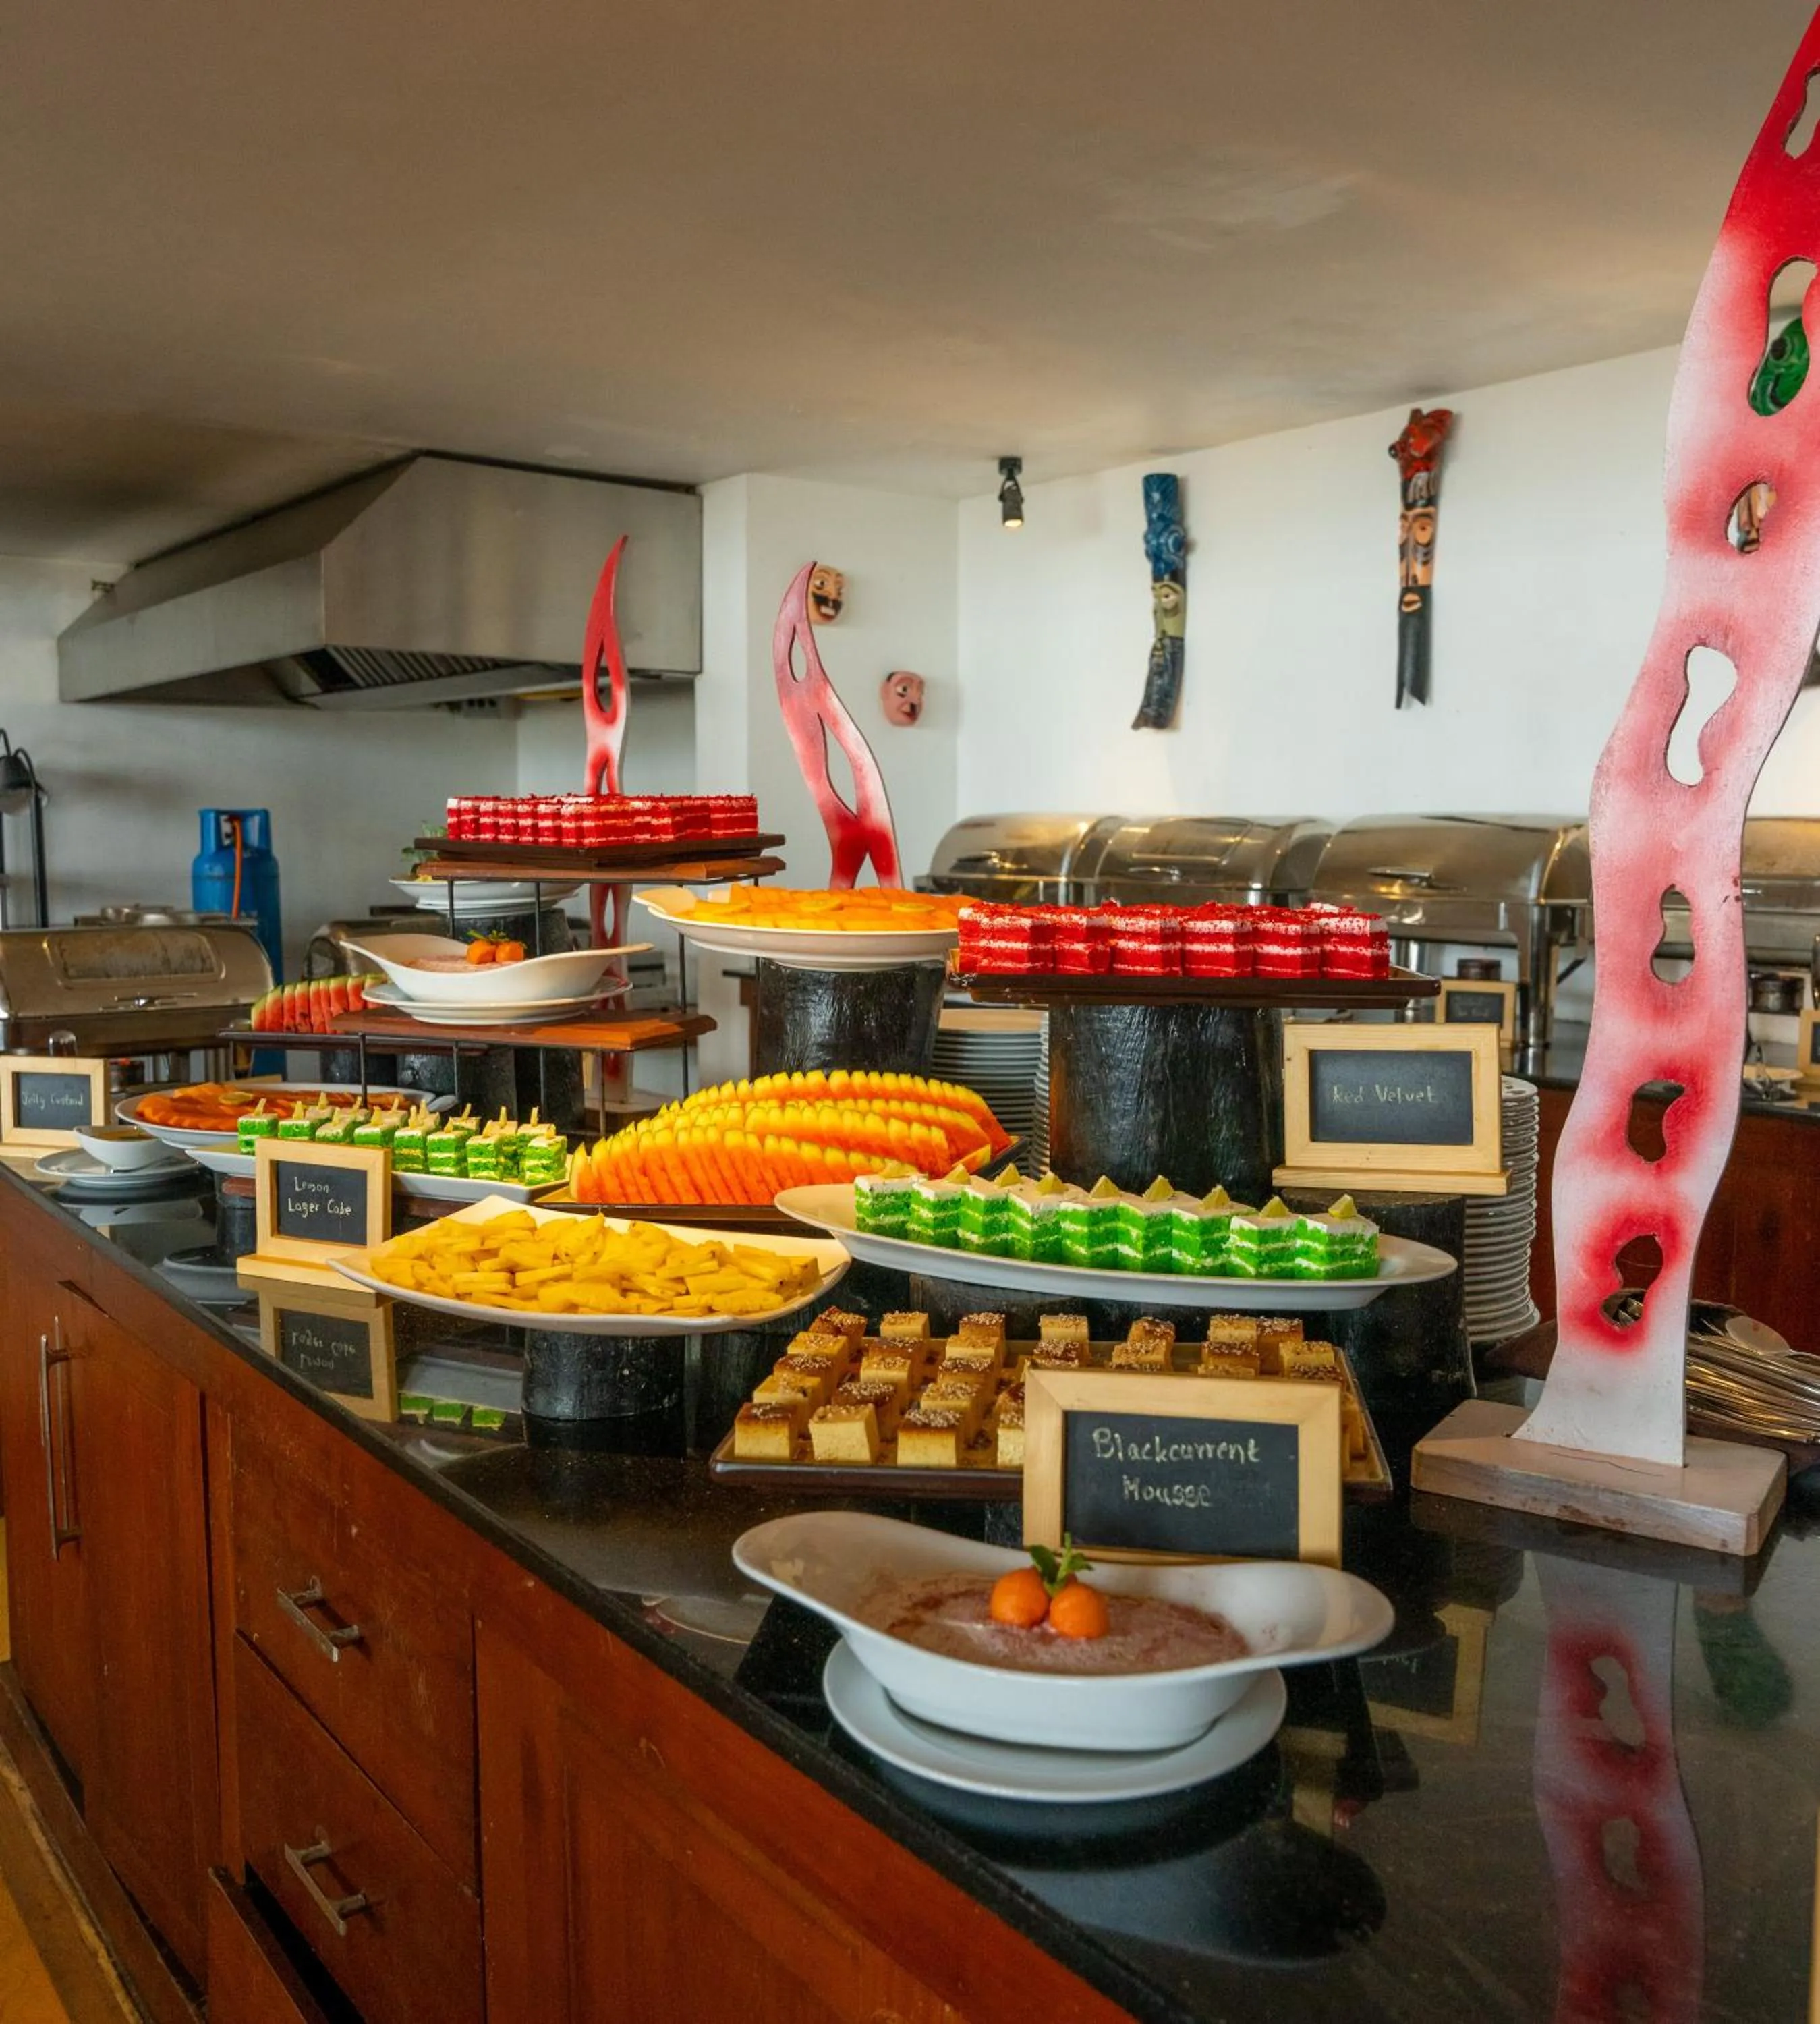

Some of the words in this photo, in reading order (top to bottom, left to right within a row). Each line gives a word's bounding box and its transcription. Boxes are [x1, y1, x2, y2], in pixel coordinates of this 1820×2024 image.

[1333, 1085, 1363, 1104] Red
[1375, 1084, 1438, 1104] Velvet
[294, 1176, 330, 1193] Lemon
[1092, 1427, 1260, 1465] Blackcurrent
[1122, 1474, 1212, 1509] Mousse
